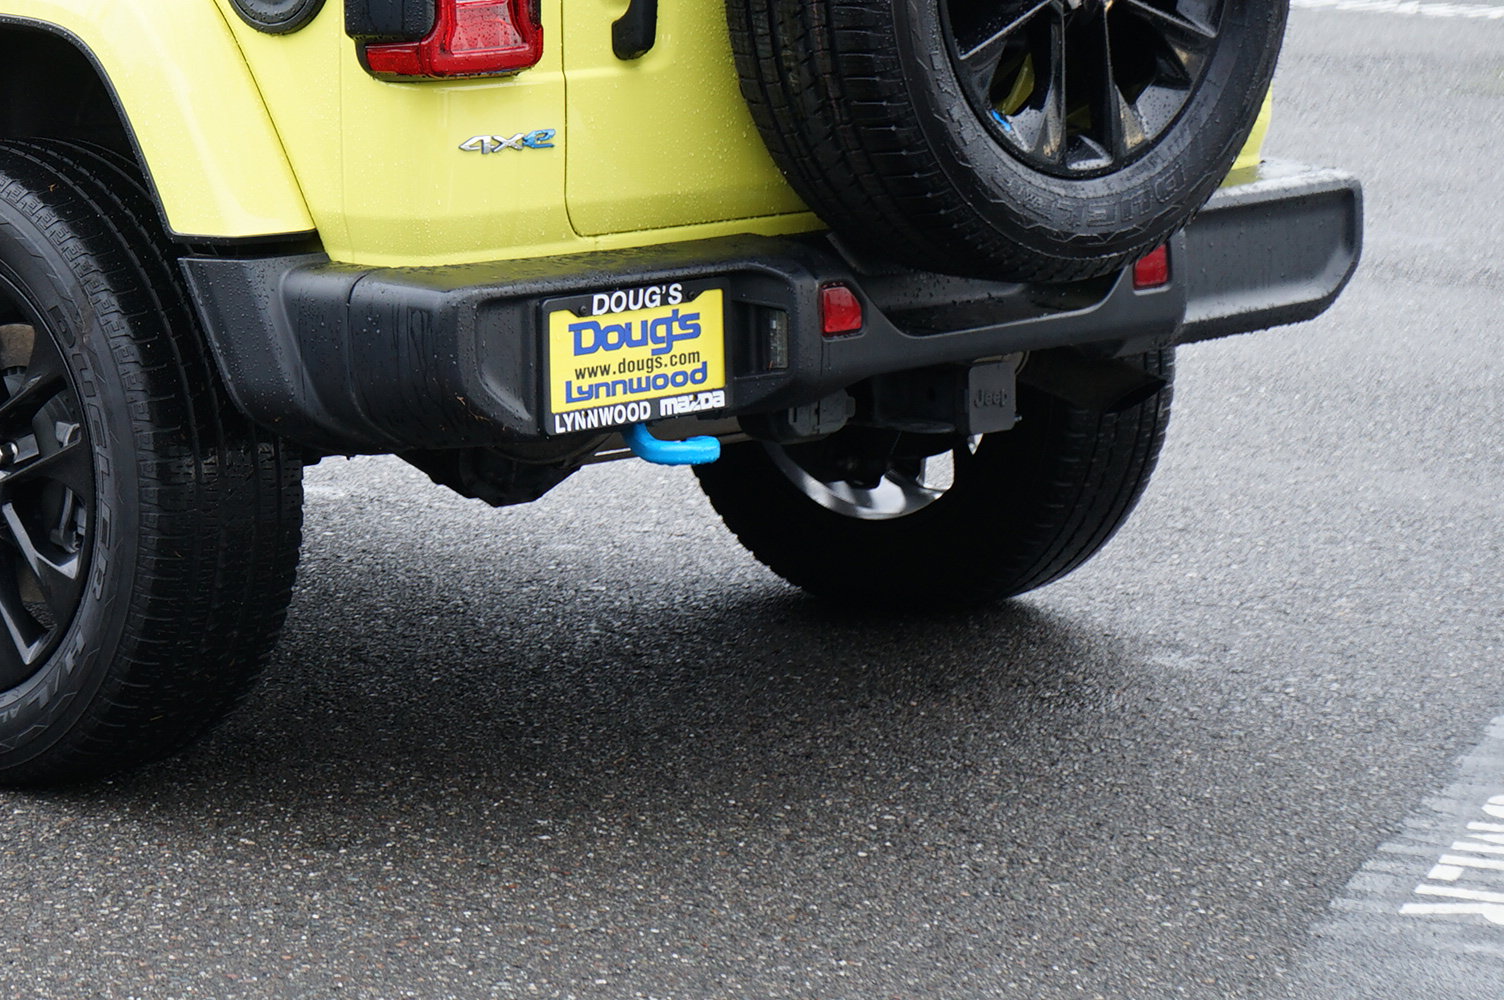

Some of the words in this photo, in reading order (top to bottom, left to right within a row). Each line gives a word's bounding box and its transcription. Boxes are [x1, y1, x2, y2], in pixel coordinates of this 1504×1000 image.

[592, 283, 683, 316] DOUG'S
[575, 351, 700, 380] www.dougs.com
[565, 361, 707, 404] Lynnwood
[973, 388, 1008, 408] Jeep
[554, 401, 651, 434] LYNNWOOD
